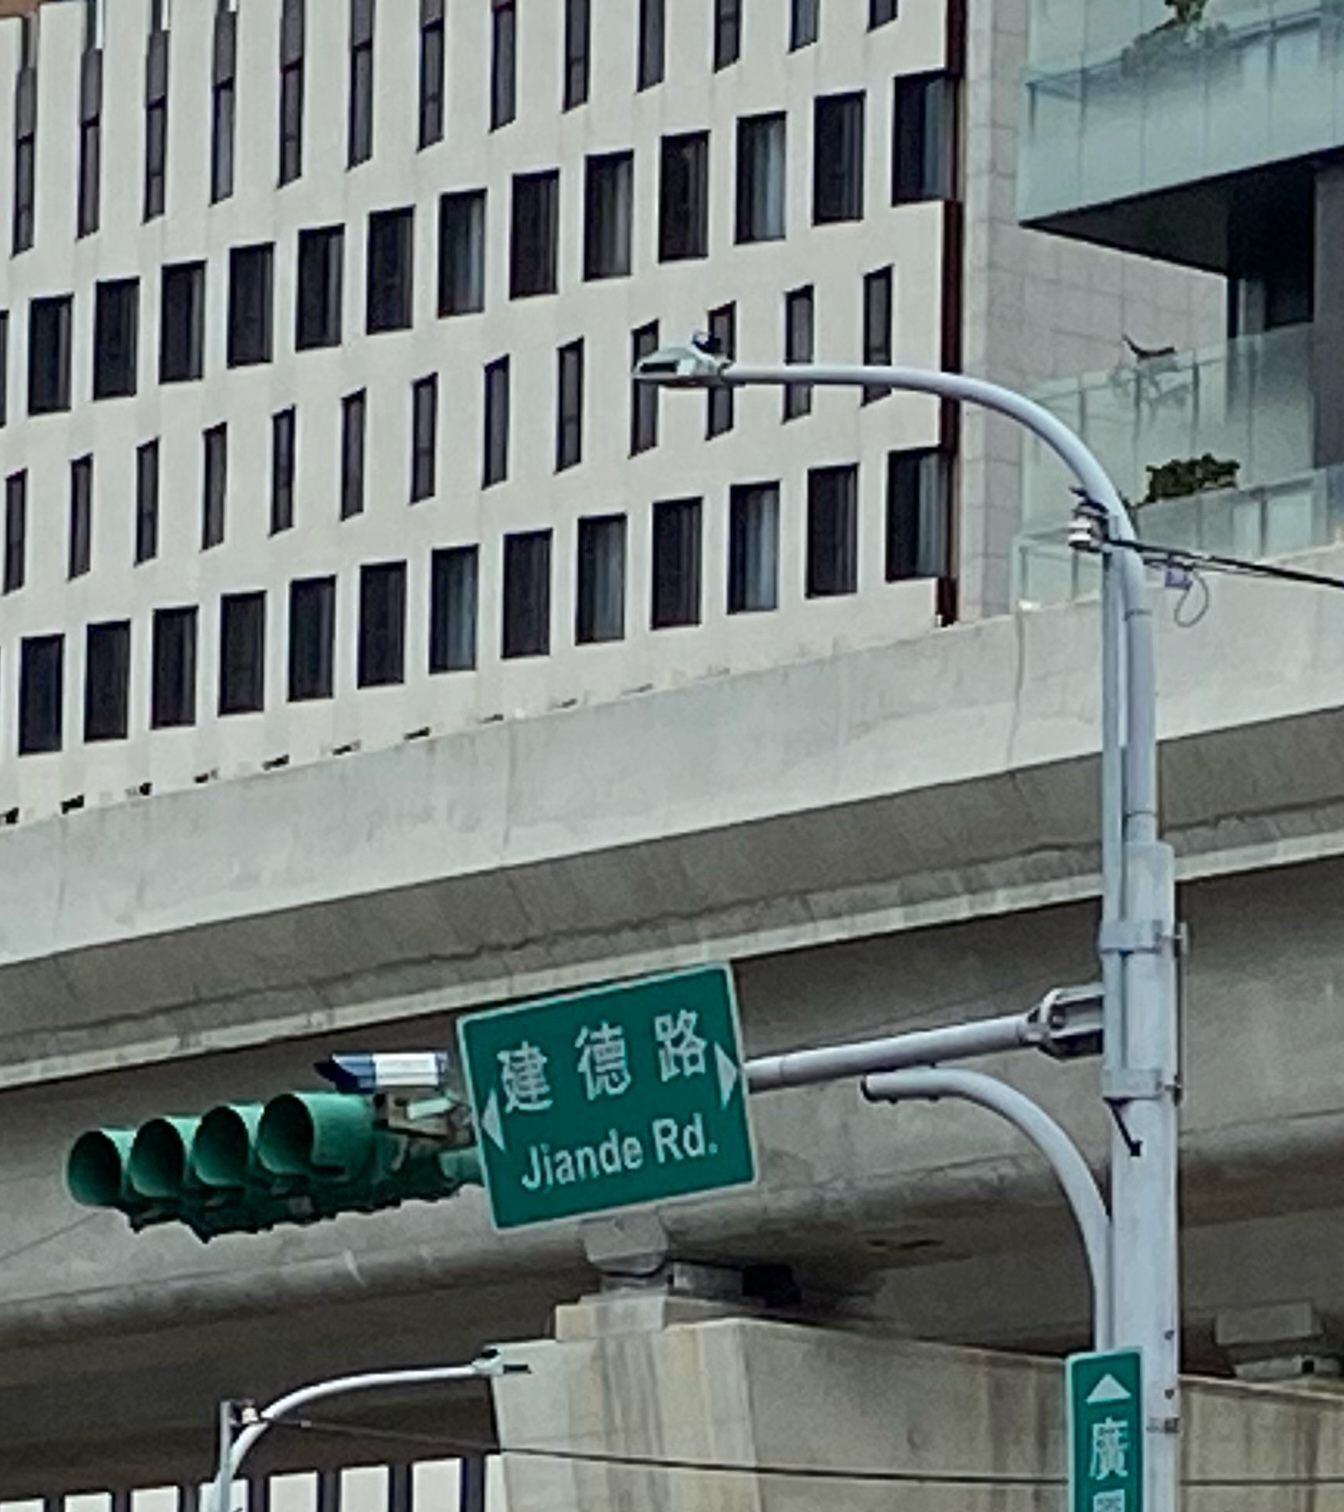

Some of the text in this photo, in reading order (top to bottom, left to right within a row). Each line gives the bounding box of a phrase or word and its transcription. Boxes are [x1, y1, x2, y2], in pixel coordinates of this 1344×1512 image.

[496, 1008, 708, 1114] 建德路
[520, 1111, 719, 1192] Jiande Rd.
